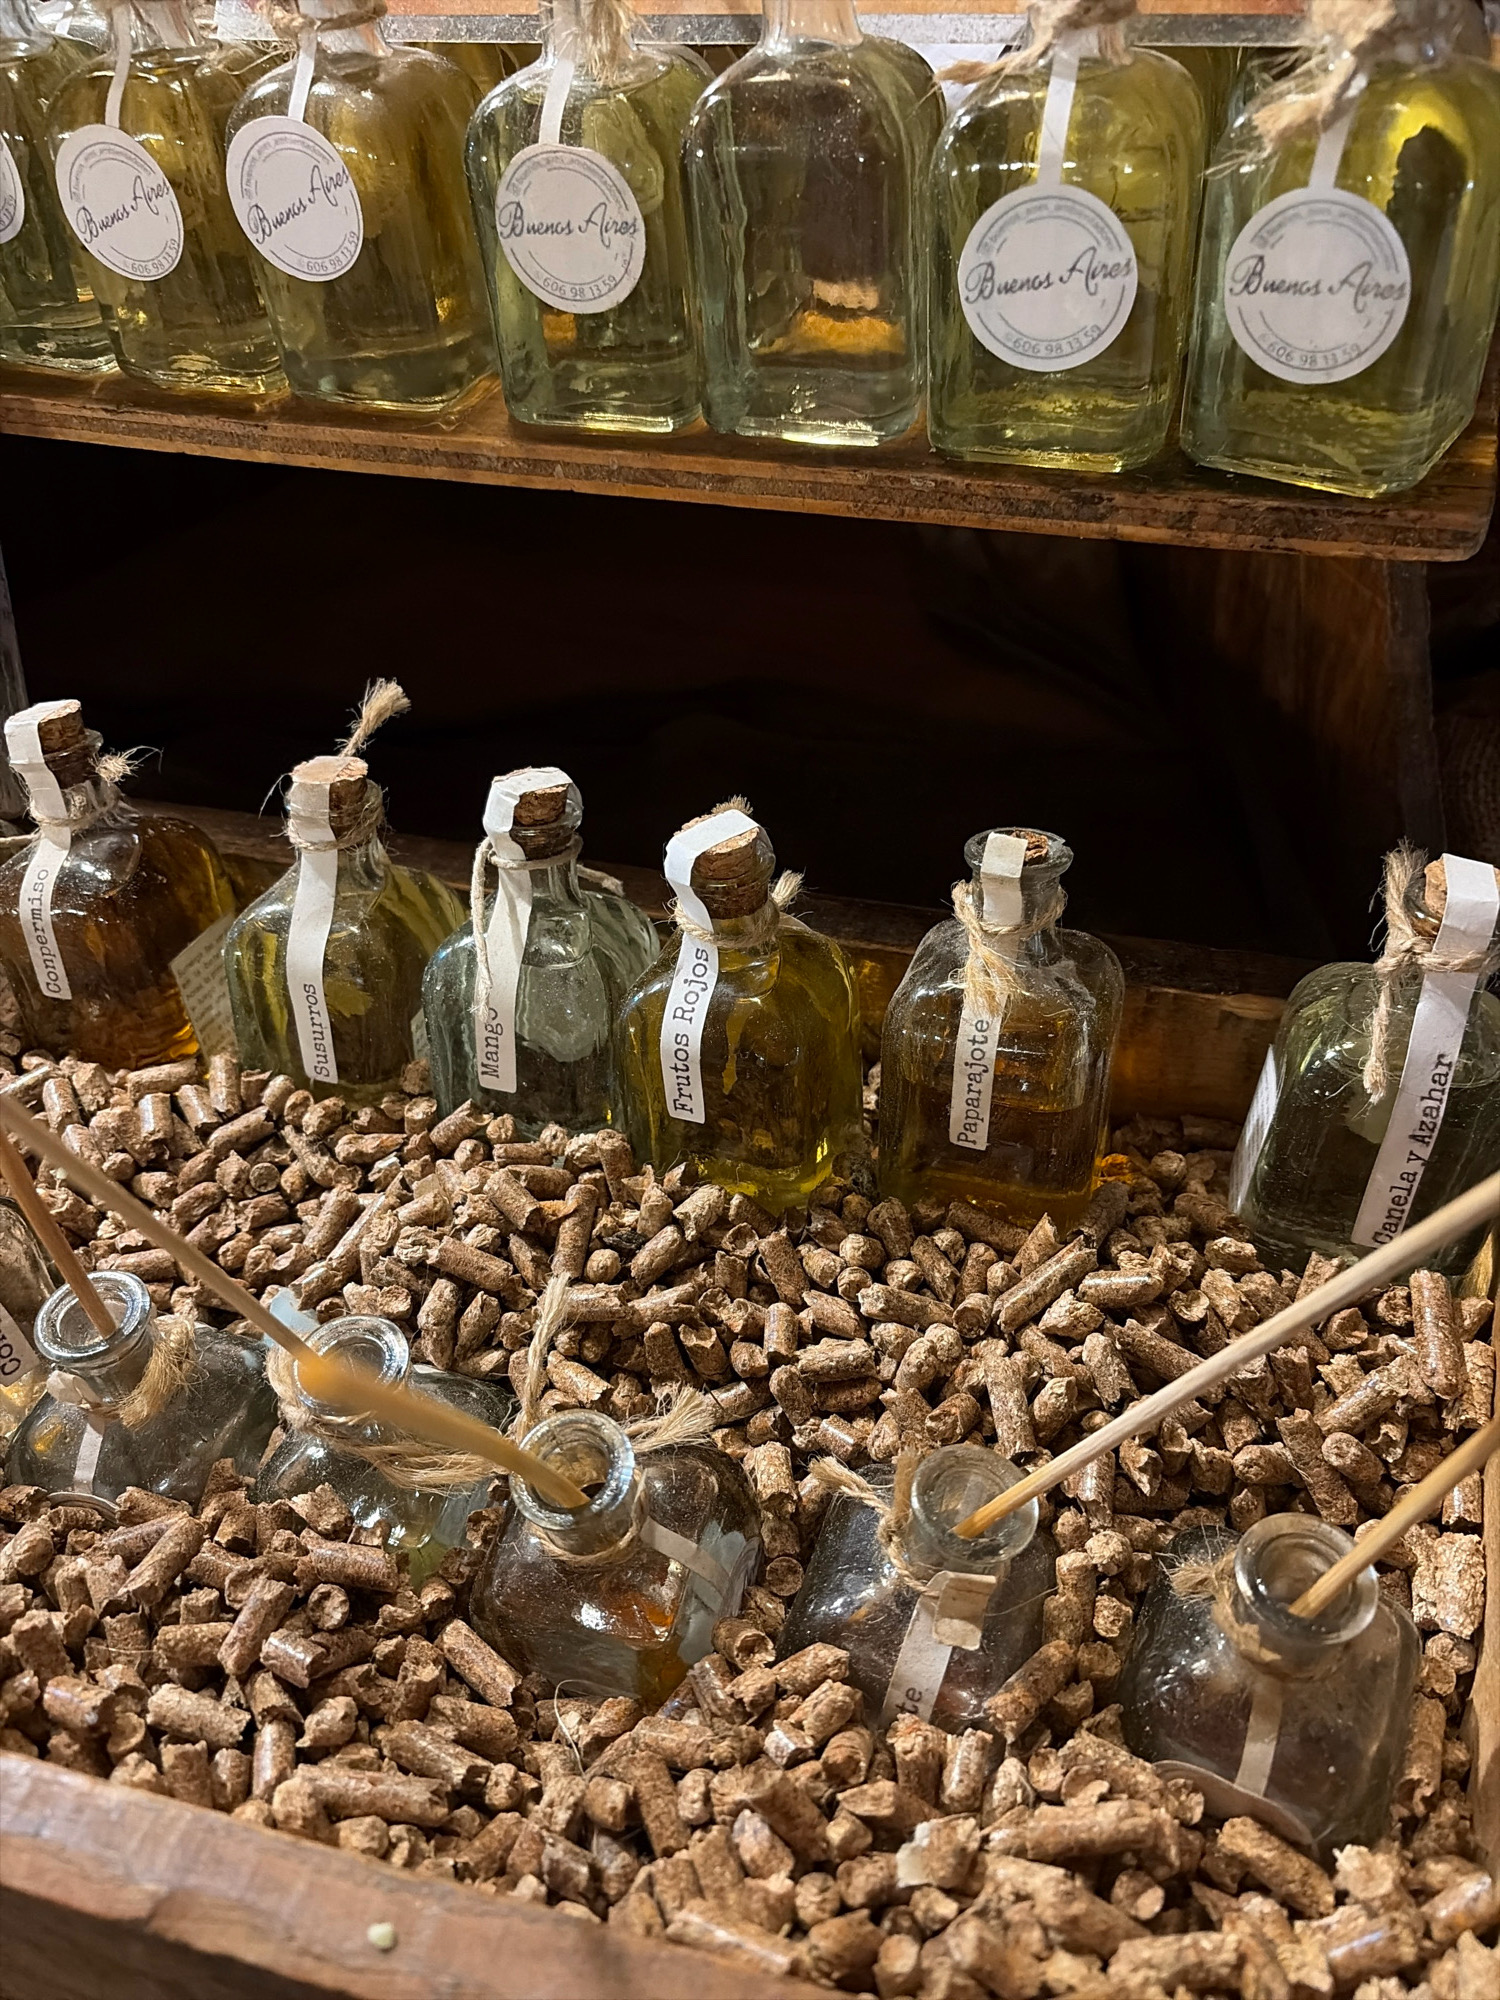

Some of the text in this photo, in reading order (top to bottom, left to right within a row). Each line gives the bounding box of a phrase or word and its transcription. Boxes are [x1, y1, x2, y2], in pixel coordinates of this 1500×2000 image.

[76, 175, 170, 244] Buenos Aires
[247, 197, 307, 245] Buenos
[308, 164, 349, 206] Aires
[499, 201, 639, 248] Buenos Aires
[131, 262, 151, 274] 606
[152, 260, 165, 272] 98
[306, 261, 328, 272] 606
[330, 255, 342, 269] 98
[341, 246, 352, 259] 13
[543, 277, 566, 296] 606
[570, 287, 585, 298] 98
[589, 284, 602, 297] 13
[964, 246, 1132, 304] Buenos Aires
[1229, 255, 1407, 314] Buenos Aires
[1013, 338, 1040, 354] 606
[1044, 342, 1063, 355] 98
[1067, 337, 1083, 350] 13
[1267, 341, 1293, 362] 606
[1300, 354, 1317, 367] 98
[28, 869, 61, 993] Conpermiso
[304, 983, 330, 1078] Susurros
[669, 948, 709, 1115] Frutos Rojos
[957, 1020, 990, 1145] Paparajote
[1372, 1053, 1452, 1244] Canela y Azahar
